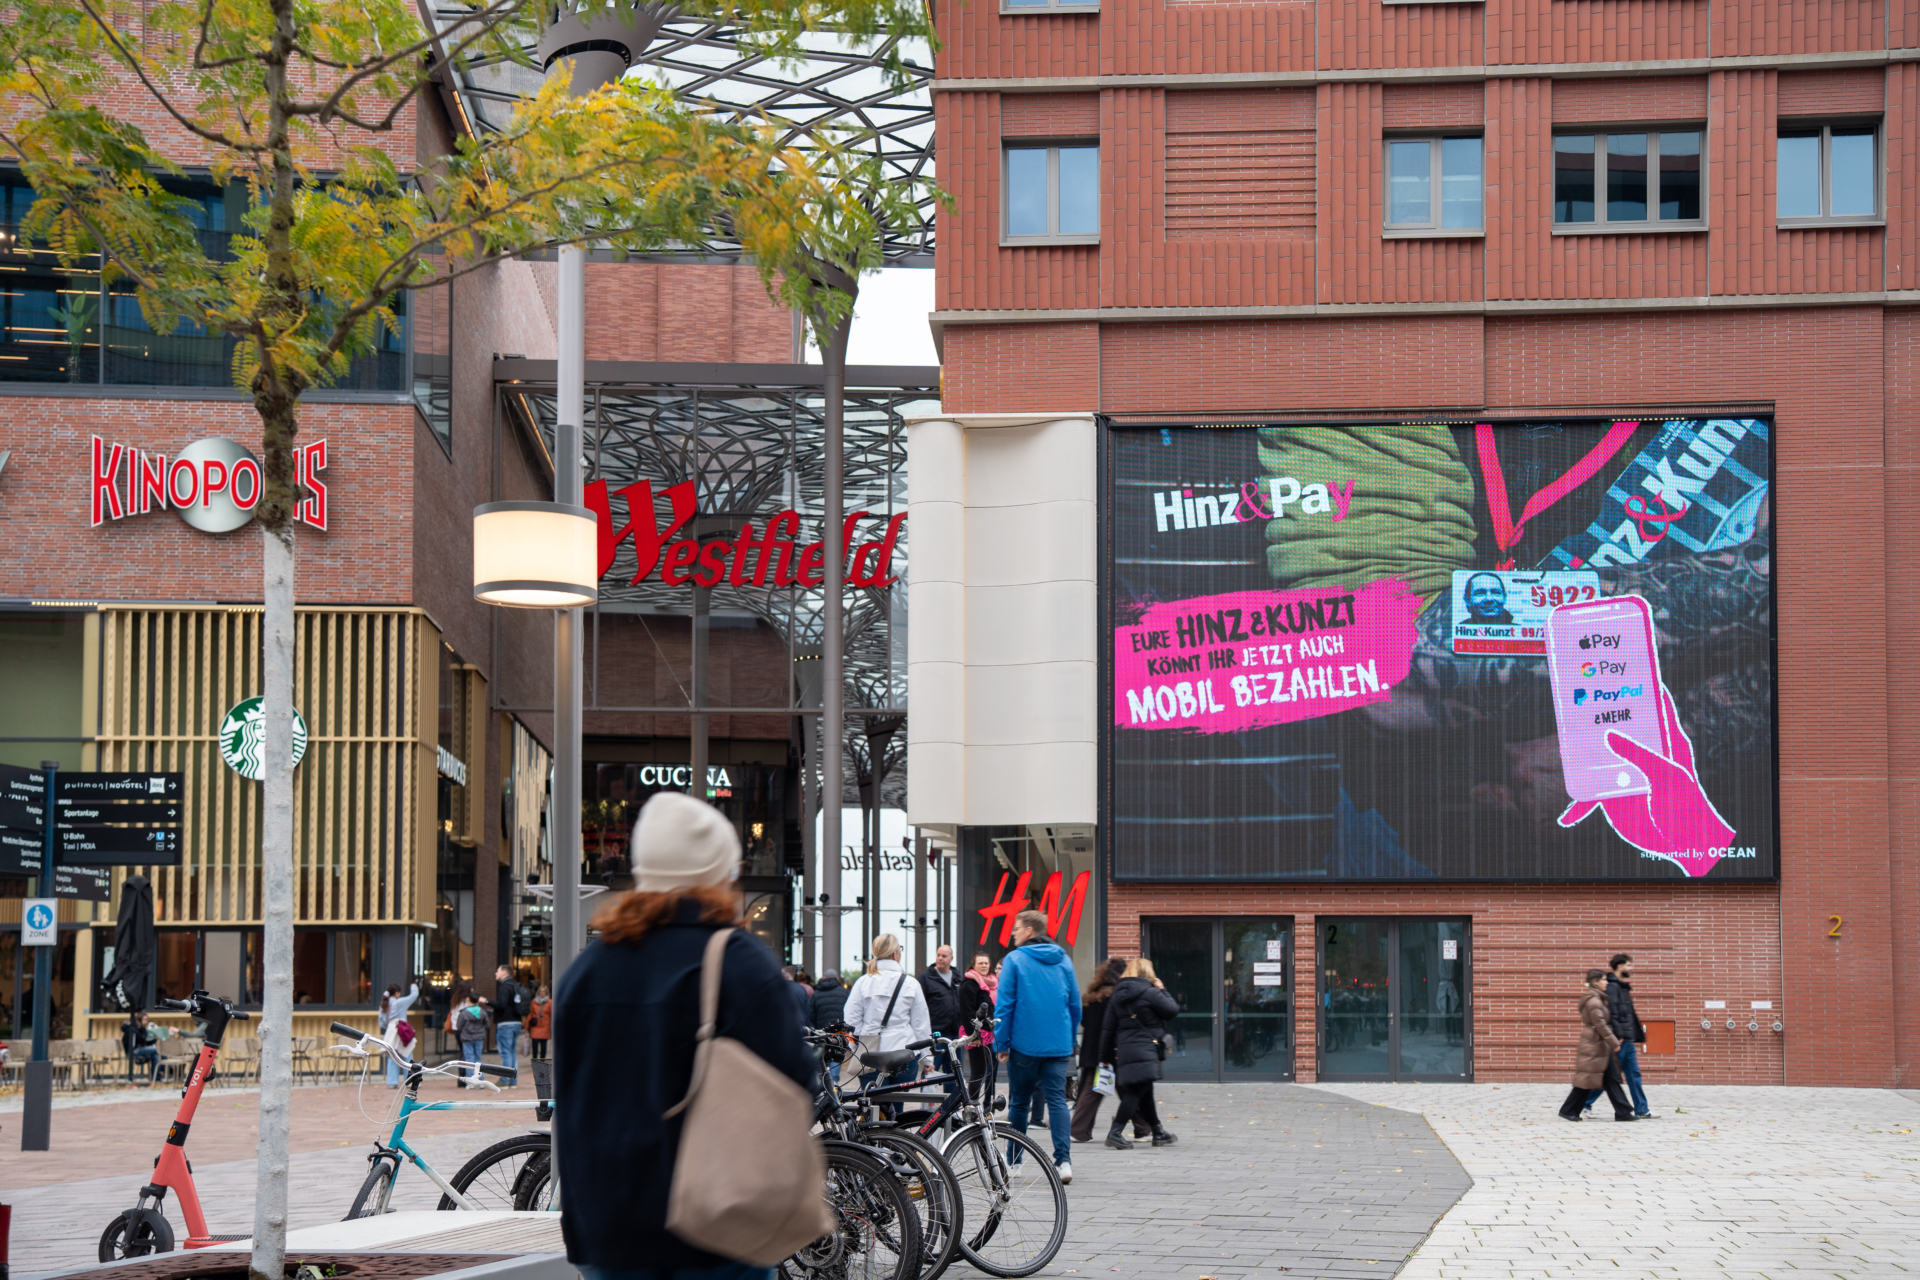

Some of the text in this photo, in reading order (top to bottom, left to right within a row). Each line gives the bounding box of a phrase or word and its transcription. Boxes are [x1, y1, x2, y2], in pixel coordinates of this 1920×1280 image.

[91, 434, 328, 531] KINOPOIS
[1153, 476, 1356, 533] Hinz&Pay
[1530, 585, 1597, 608] 5922
[1130, 628, 1171, 654] EURE
[1591, 634, 1621, 650] Pay
[1147, 634, 1345, 677] KÖNNT IHR JETZT AUCH
[1599, 660, 1627, 676] Pay
[1125, 658, 1390, 726] MOBIL BEZAHLEN.
[1593, 684, 1643, 702] PayPal
[64, 782, 104, 790] pullman
[109, 779, 144, 789] NOVOTEL
[63, 809, 99, 818] Sportanlage
[63, 832, 85, 840] U-Bahn
[63, 842, 96, 850] Taxi MOIA
[1640, 846, 1756, 861] supported by OCEAN
[977, 870, 1091, 948] HM
[29, 930, 50, 938] ZONE
[1327, 924, 1338, 945] 2
[1828, 914, 1842, 936] 2
[919, 1111, 941, 1135] KETTLER
